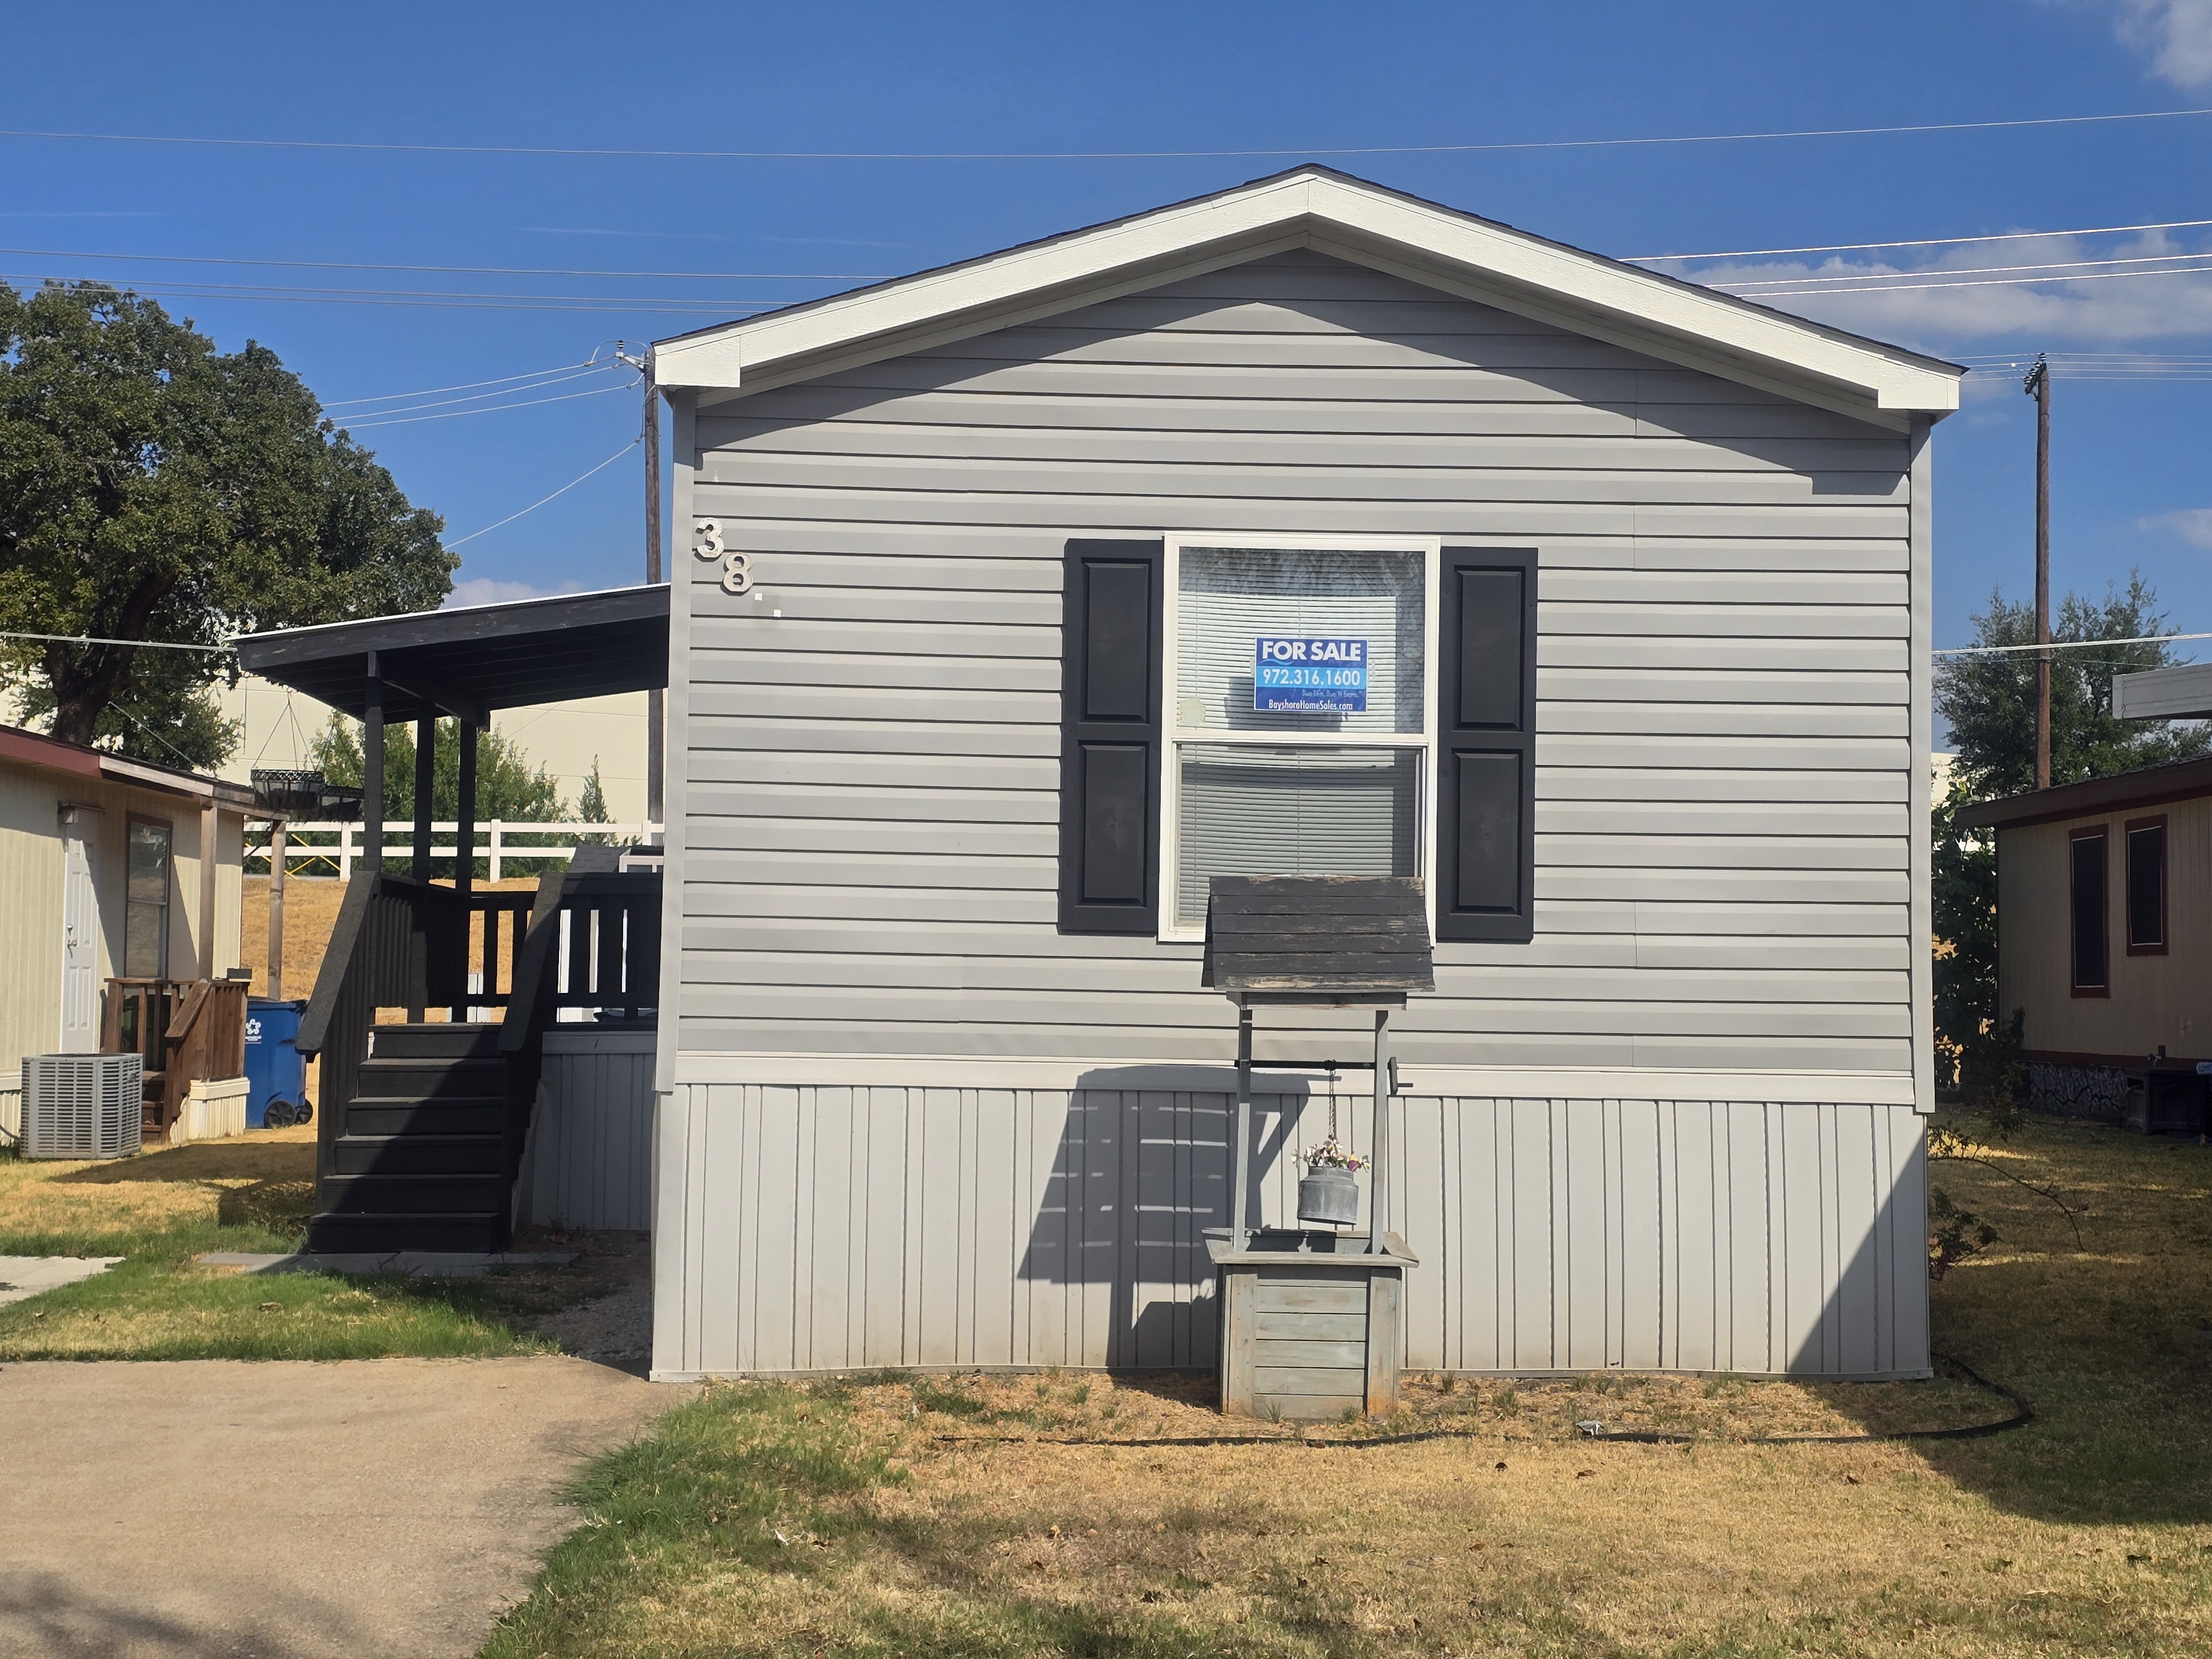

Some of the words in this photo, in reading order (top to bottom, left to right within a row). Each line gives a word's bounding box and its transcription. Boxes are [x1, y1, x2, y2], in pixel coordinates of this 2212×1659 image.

[1262, 641, 1307, 660] FOR
[1310, 642, 1361, 661] SALE
[1263, 669, 1360, 686] 972.316.1600
